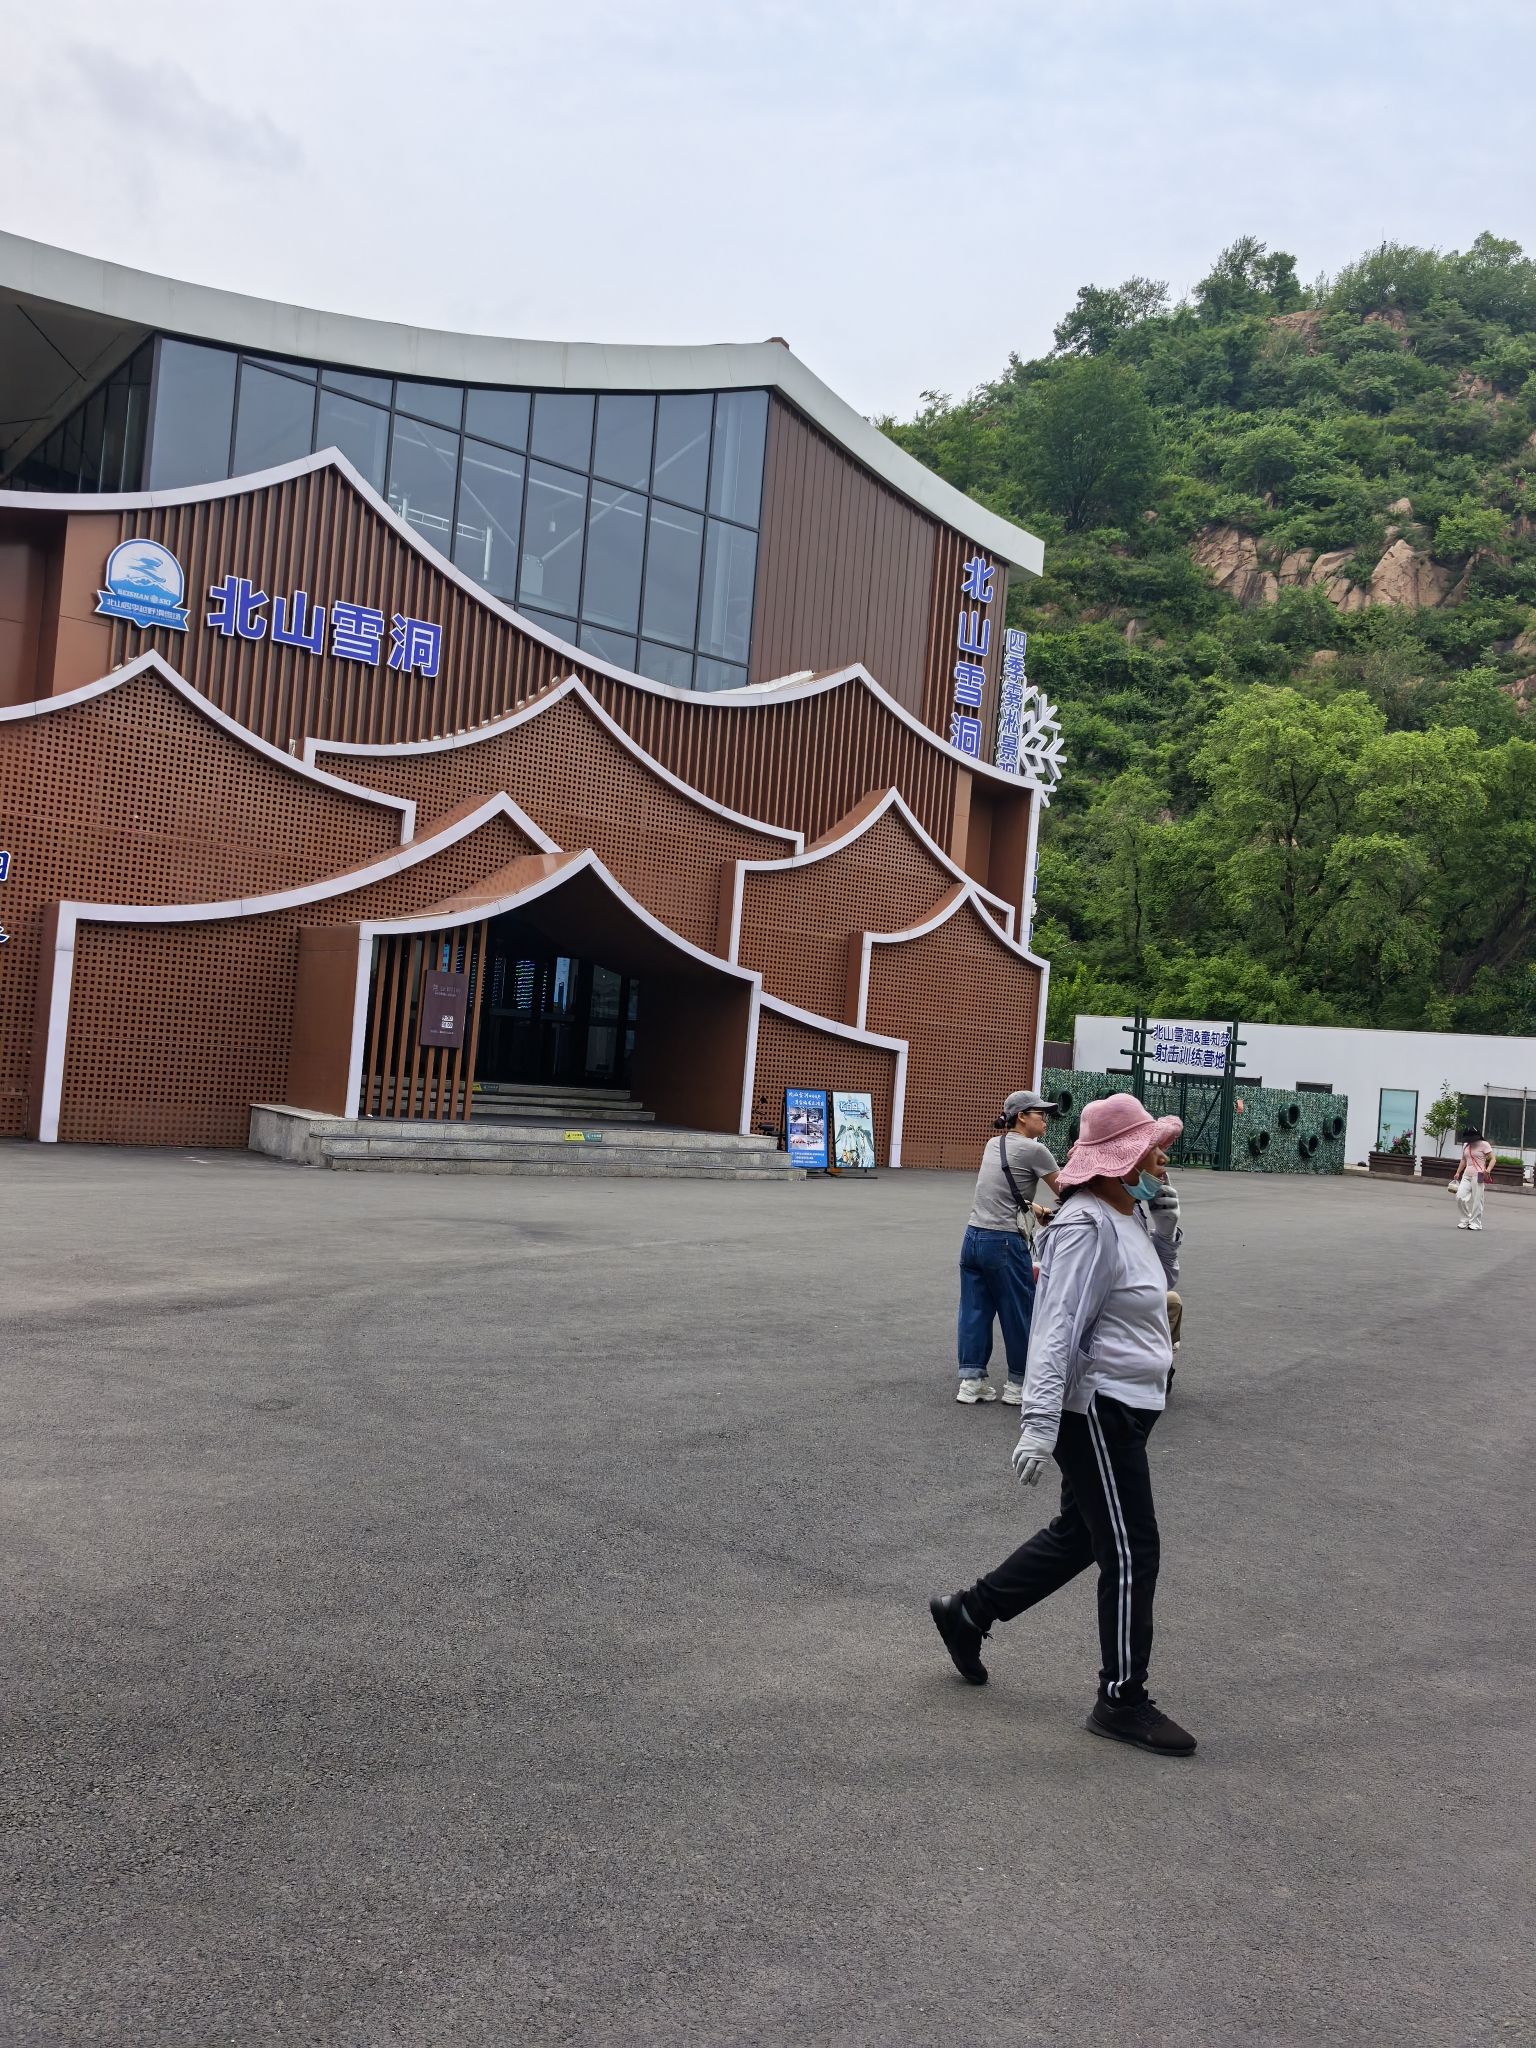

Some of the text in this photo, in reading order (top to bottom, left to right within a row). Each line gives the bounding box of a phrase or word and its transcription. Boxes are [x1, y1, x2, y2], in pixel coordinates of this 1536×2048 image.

[117, 588, 172, 606] BEISHAN SKI
[207, 575, 442, 677] 北山雪洞
[951, 556, 995, 760] 北山雪洞
[1154, 1043, 1225, 1069] 射击训练营地
